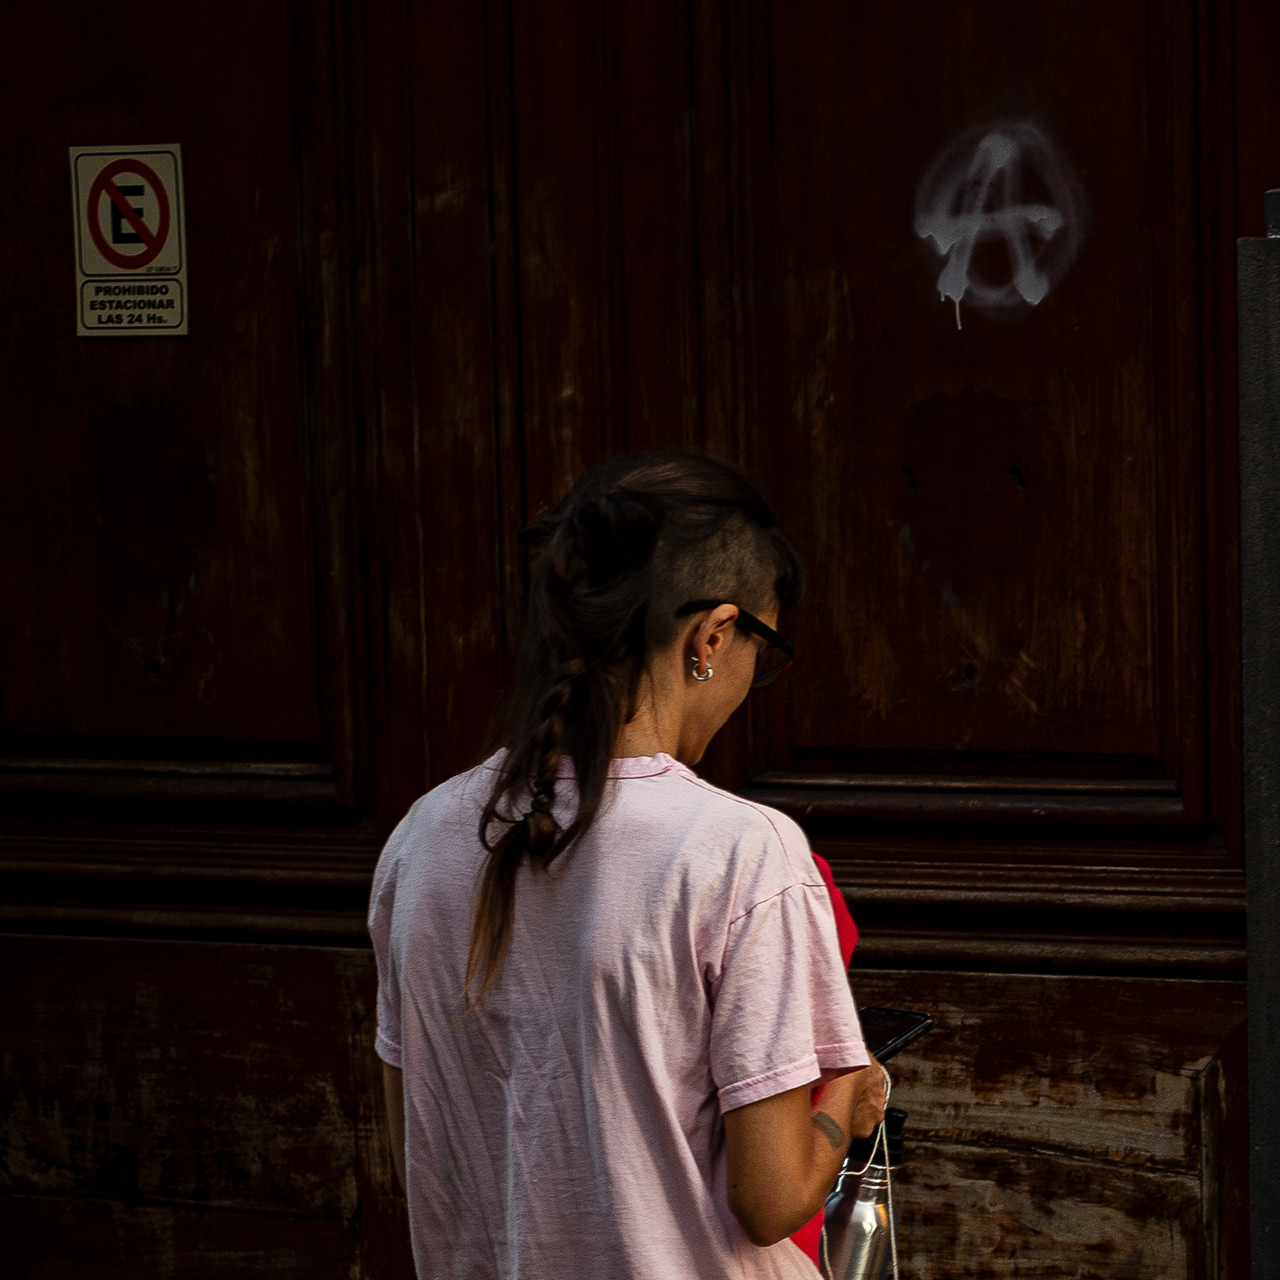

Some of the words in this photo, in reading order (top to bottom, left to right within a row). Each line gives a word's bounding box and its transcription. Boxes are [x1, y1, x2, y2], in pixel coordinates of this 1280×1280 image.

[95, 285, 169, 296] PROHIBIDO
[90, 299, 175, 310] ESTACIONAR
[97, 313, 123, 324] LAS
[127, 313, 143, 324] 24
[147, 313, 167, 323] Hs.
